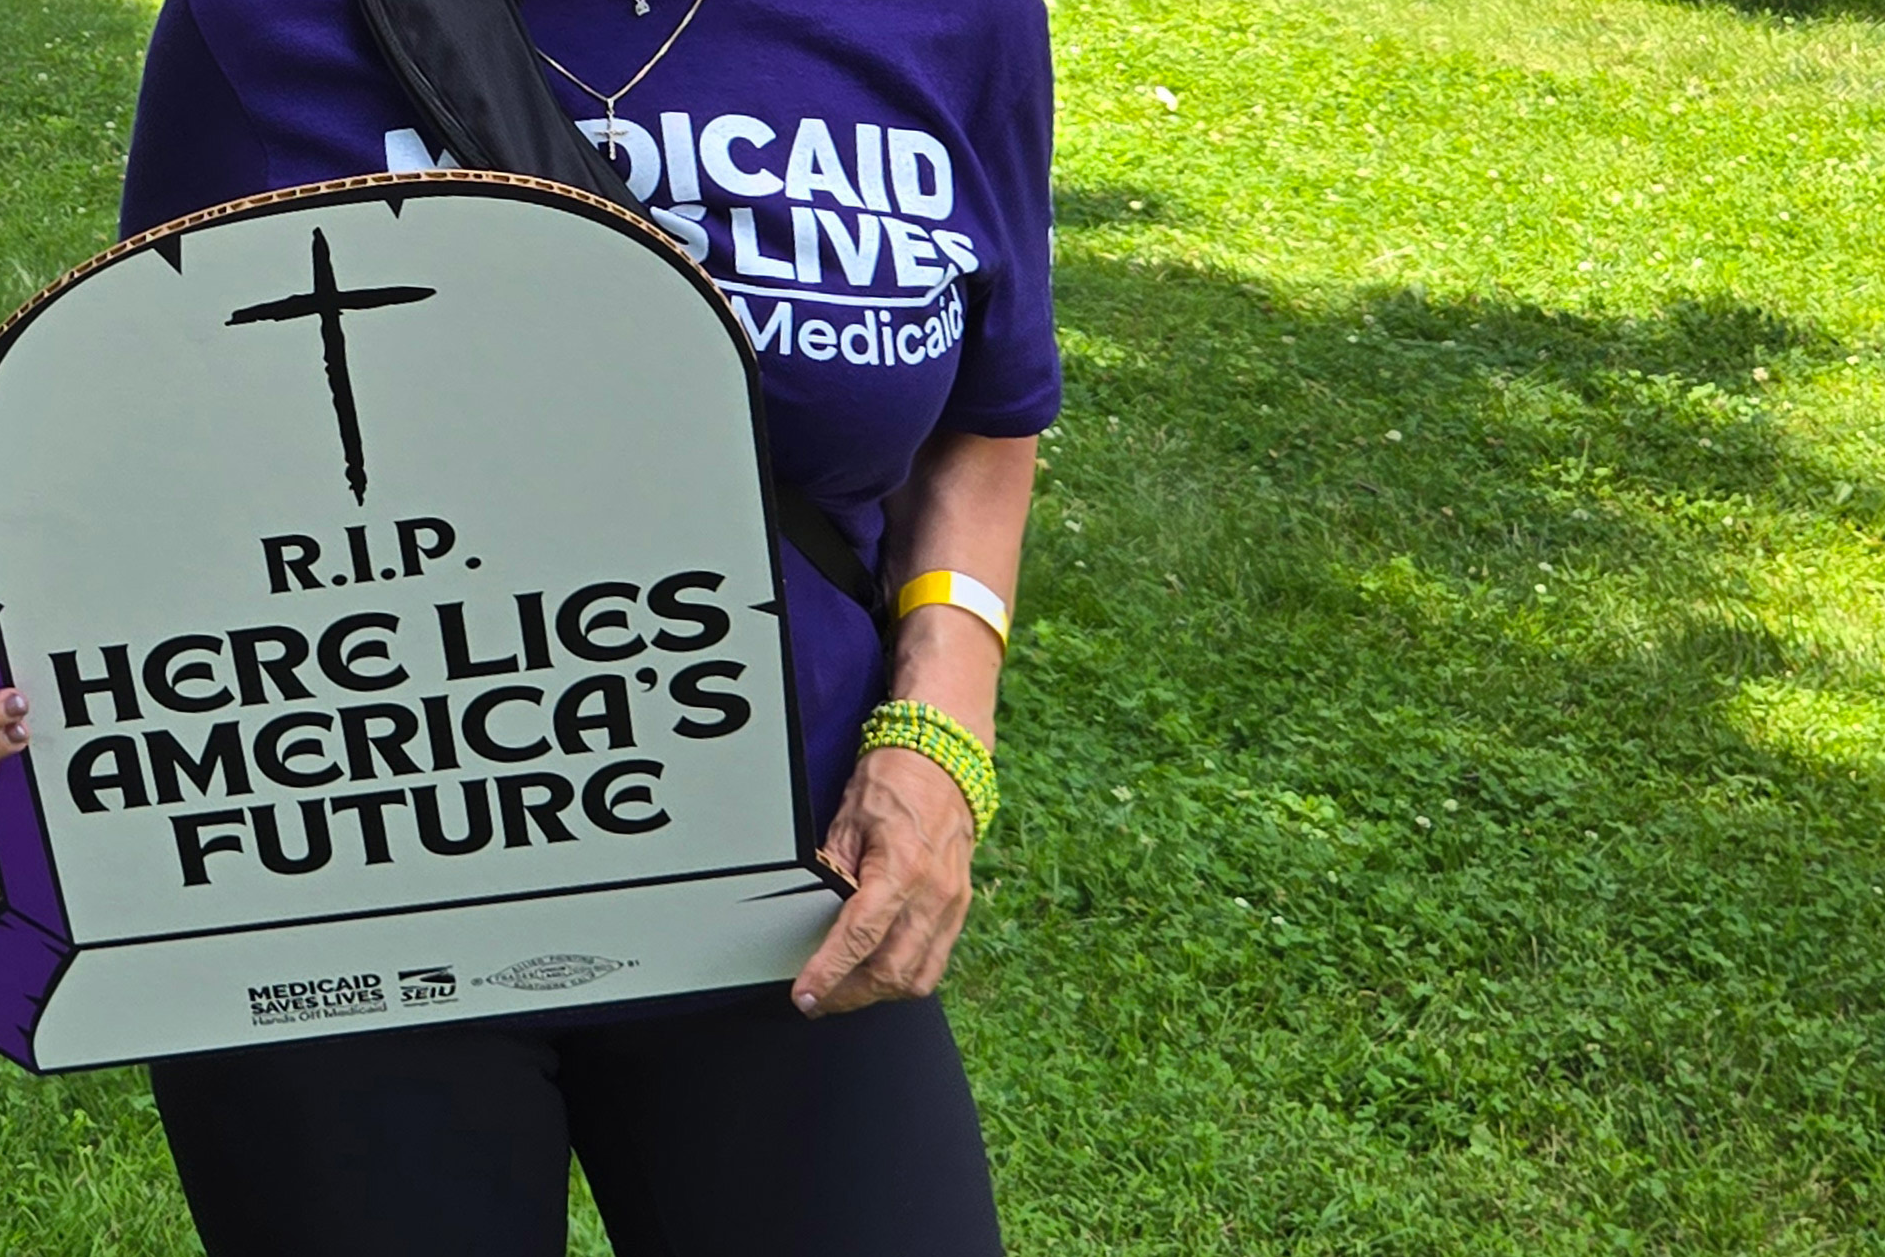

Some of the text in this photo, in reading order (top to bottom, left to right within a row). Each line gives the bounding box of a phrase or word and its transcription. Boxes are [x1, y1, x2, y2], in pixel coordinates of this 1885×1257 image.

[383, 111, 954, 221] DICAID
[731, 206, 979, 287] LIVES
[731, 283, 965, 367] Medicaid
[260, 517, 482, 594] R.I.P.
[48, 570, 731, 728] HERE LIES
[67, 660, 752, 814] AMERICA'S
[169, 759, 672, 887] FUTURE
[248, 974, 382, 1002] MEDICAID
[251, 995, 320, 1016] SAVES
[323, 988, 385, 1008] LIVES
[253, 1009, 296, 1027] Hands
[299, 1006, 322, 1023] Off
[322, 1001, 388, 1020] Medicaid
[399, 984, 456, 1003] SEIU
